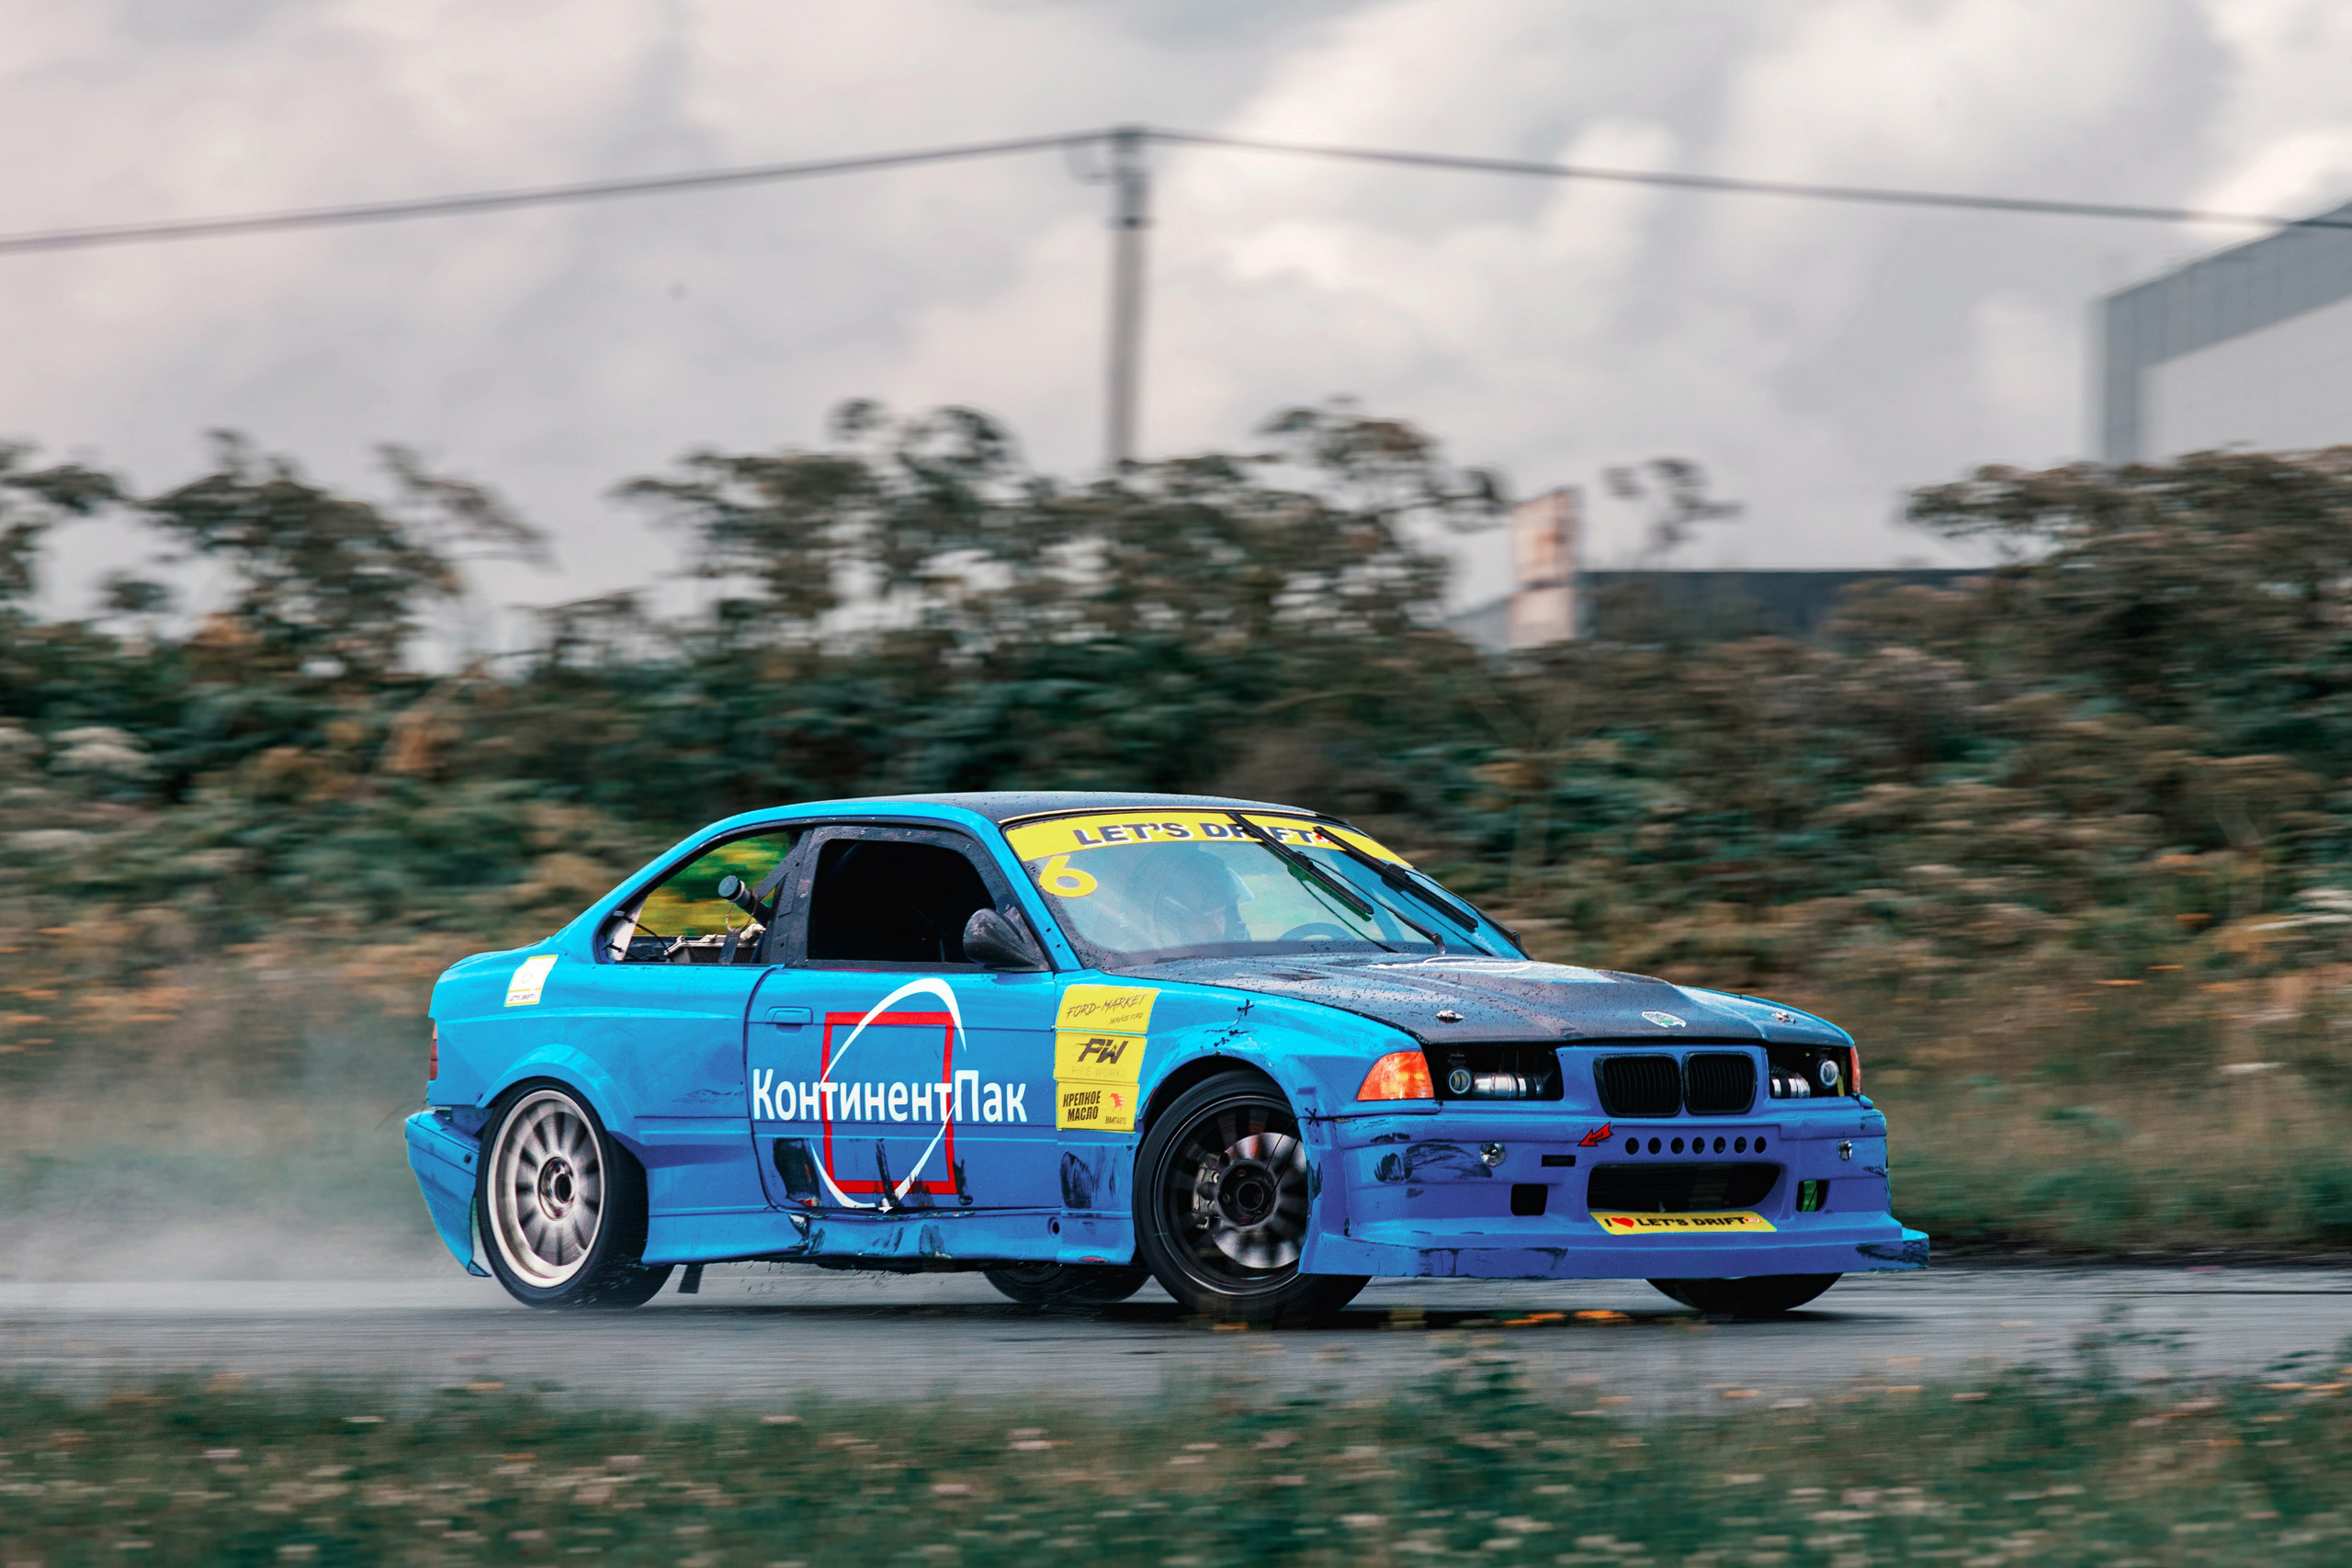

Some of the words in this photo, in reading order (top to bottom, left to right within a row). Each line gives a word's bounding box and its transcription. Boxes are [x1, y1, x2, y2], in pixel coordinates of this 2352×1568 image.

[1072, 822, 1193, 847] LET'S
[1198, 822, 1316, 846] DRFT
[1038, 855, 1098, 898] 6
[1095, 1066, 1126, 1078] WORKS
[752, 1068, 1028, 1122] КонтинентПак
[1062, 1090, 1102, 1108] КРЕПКОЕ
[1067, 1106, 1099, 1122] МАСЛО
[1635, 1218, 1689, 1226] LET'S
[1690, 1216, 1746, 1226] DRIFT
